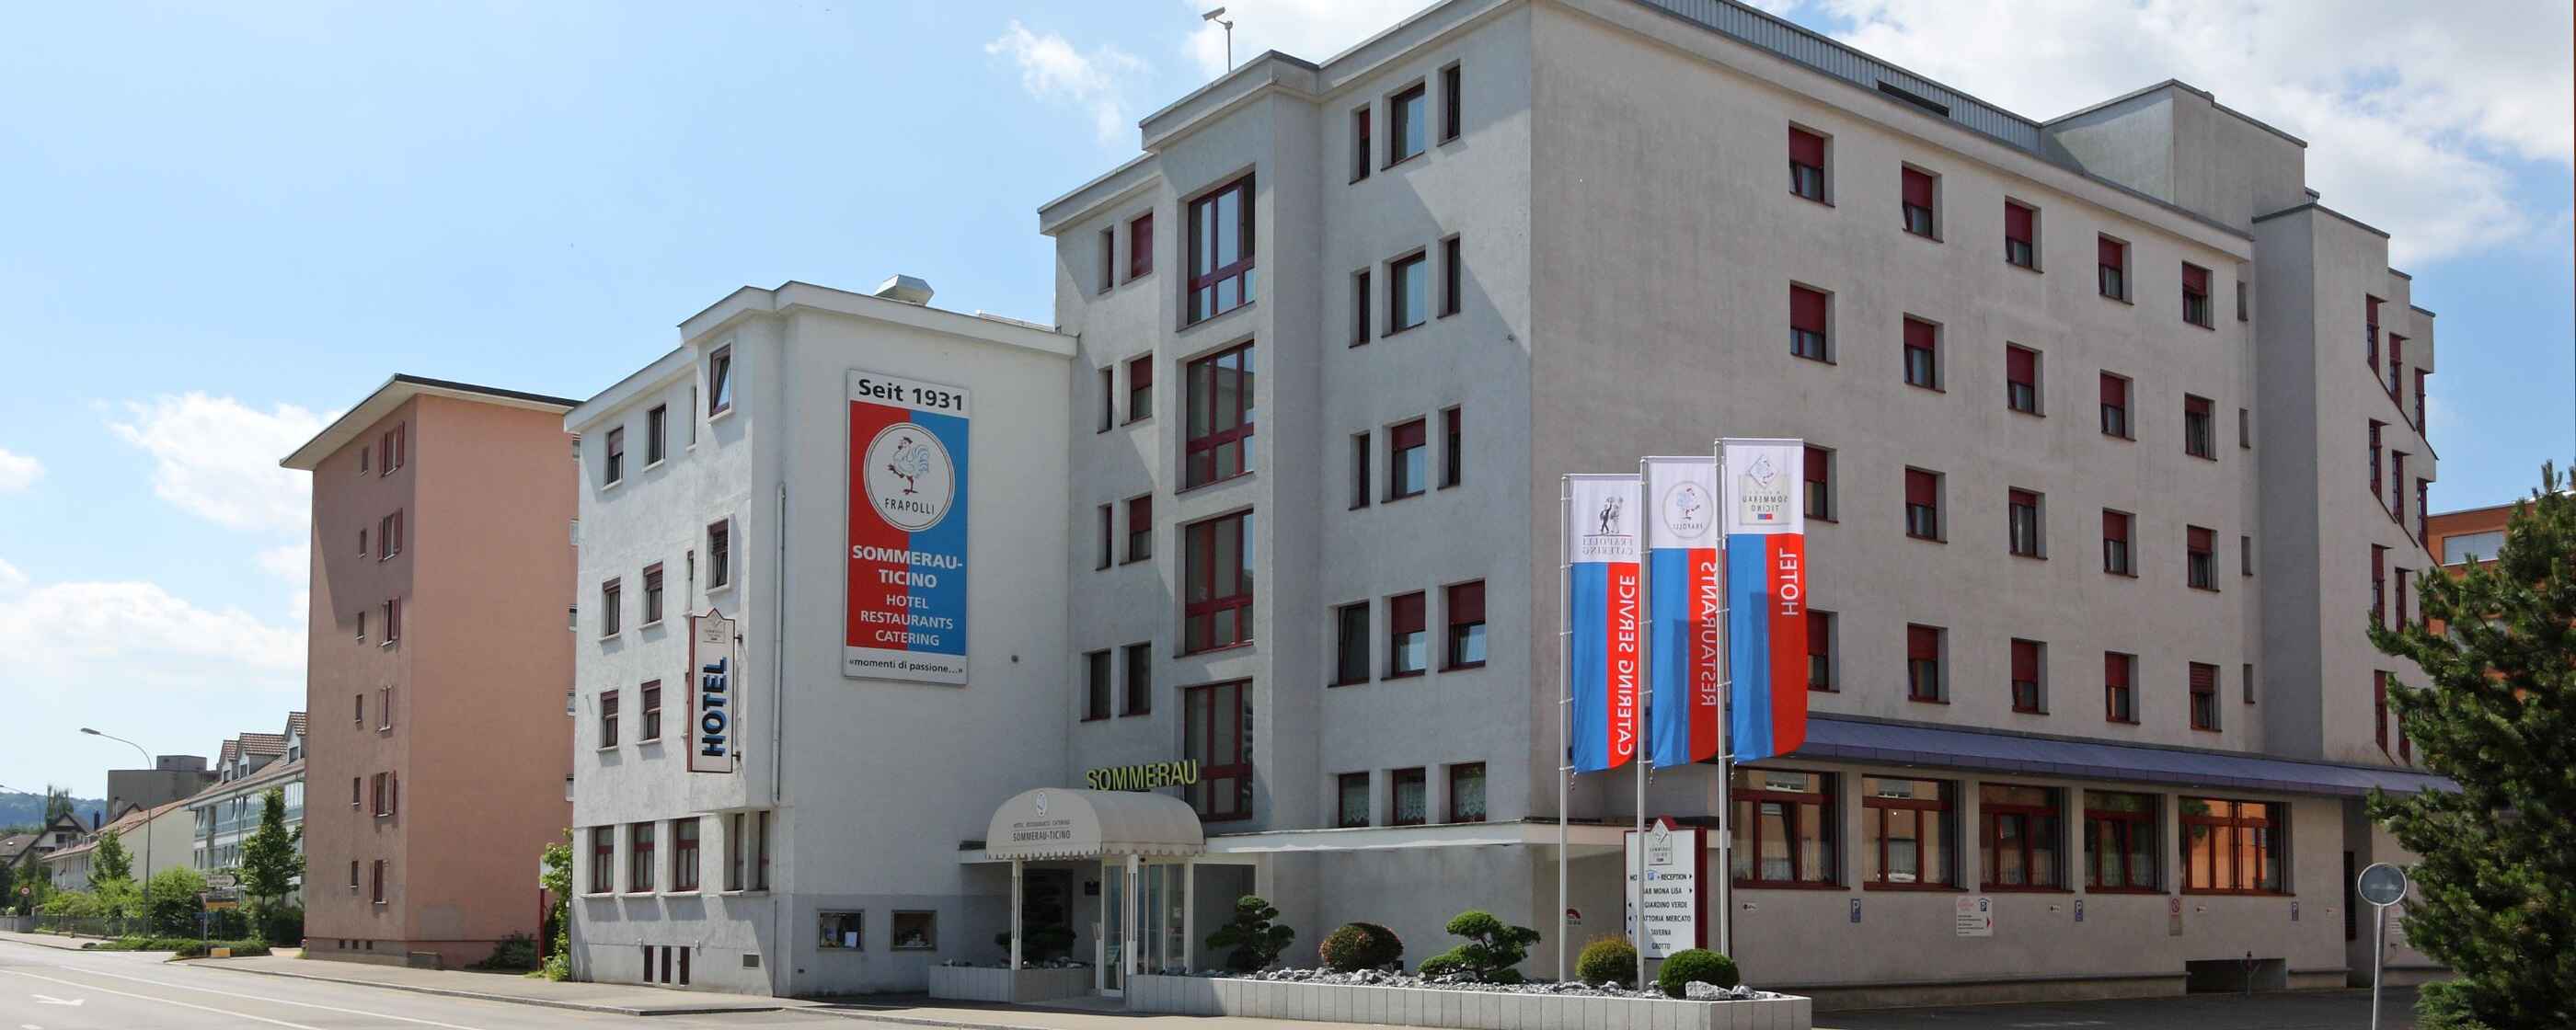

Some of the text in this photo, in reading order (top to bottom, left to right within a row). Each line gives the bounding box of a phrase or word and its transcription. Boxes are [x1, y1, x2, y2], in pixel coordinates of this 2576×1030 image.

[858, 378, 962, 412] Seit 1931
[885, 498, 935, 515] FRAPOLLI
[853, 544, 963, 570] SOMMERAU-
[879, 568, 937, 589] TICINO
[886, 594, 928, 609] HOTEL
[860, 610, 954, 630] RESTAURANTS
[875, 629, 939, 647] CATERING
[898, 660, 907, 670] di
[702, 657, 727, 756] HOTEL
[1087, 759, 1197, 791] SOMMERAU
